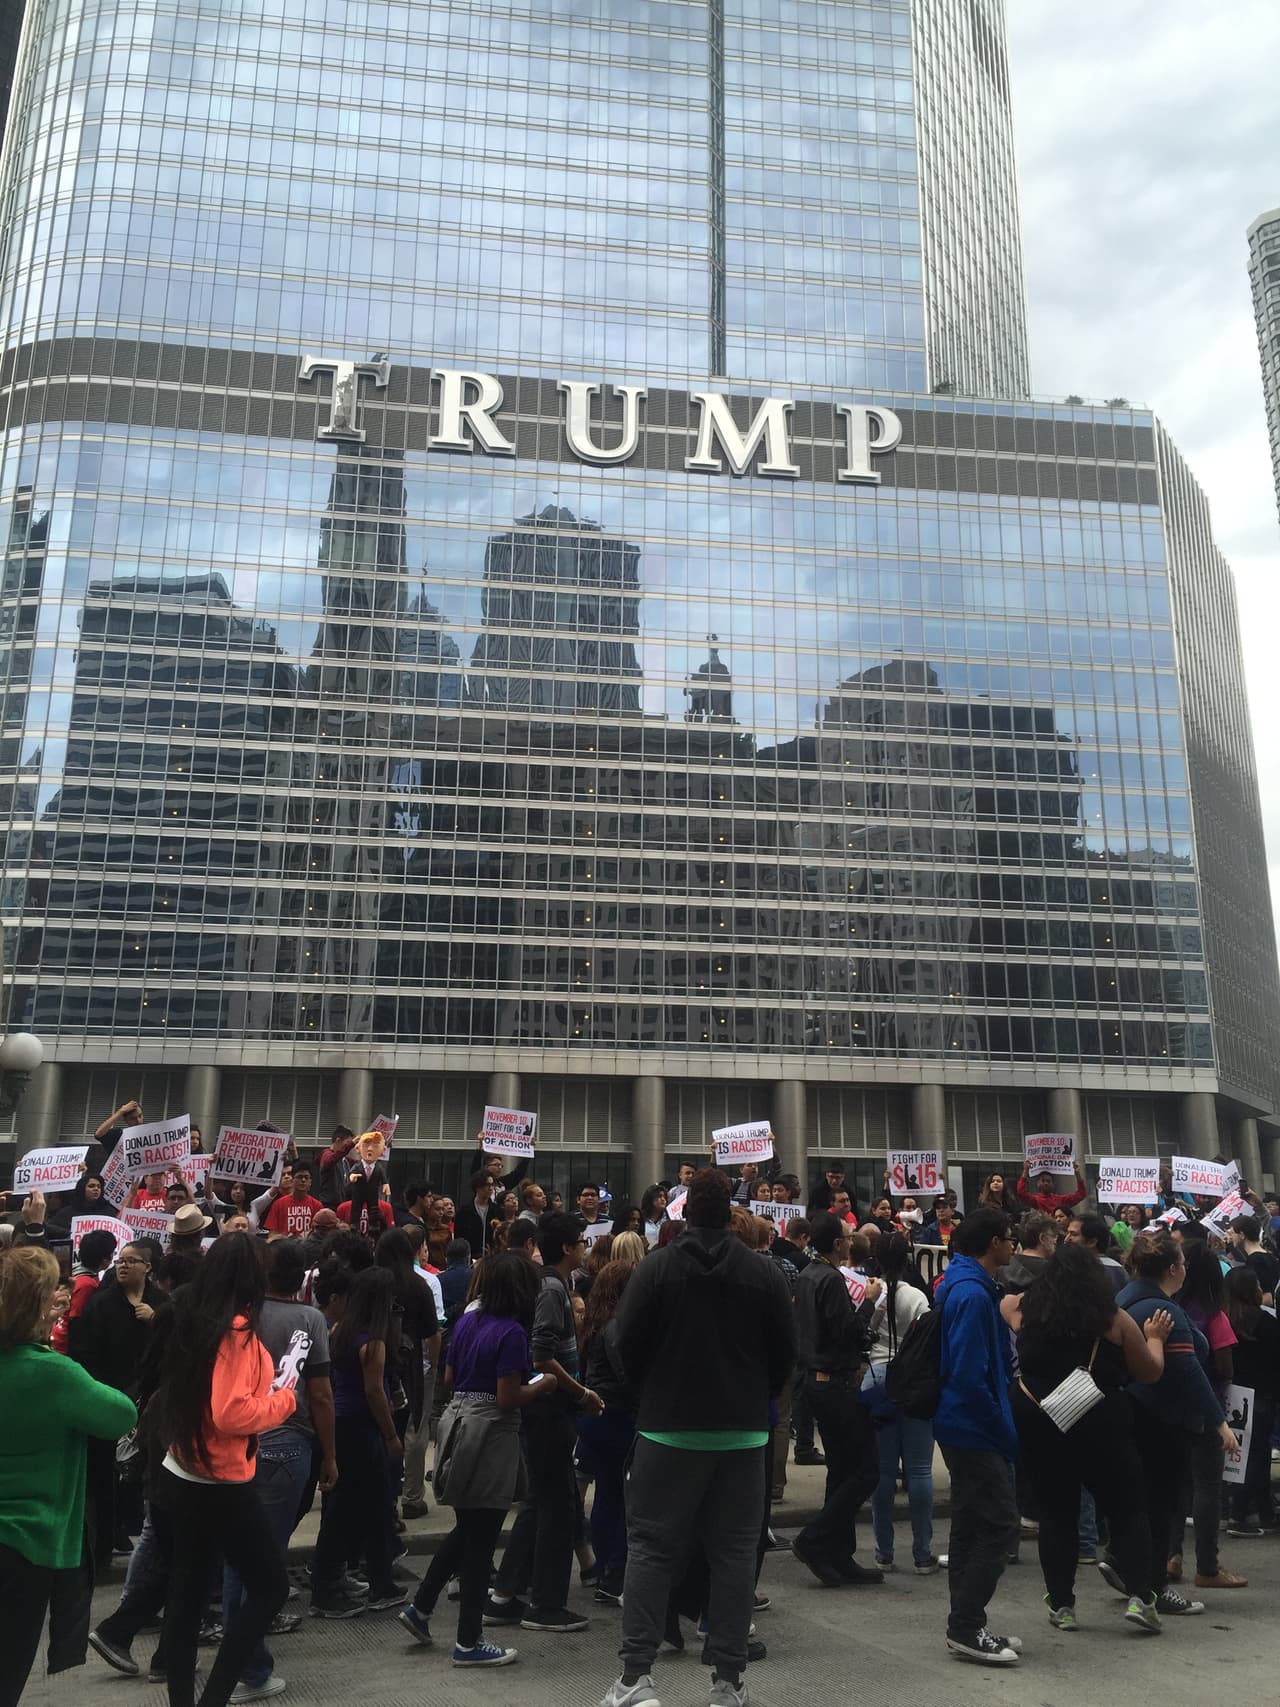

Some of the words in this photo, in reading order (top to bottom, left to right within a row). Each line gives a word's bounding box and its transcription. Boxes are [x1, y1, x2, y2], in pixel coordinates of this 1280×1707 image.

[299, 355, 903, 484] TRUMP
[486, 1121, 503, 1131] FIGHT
[504, 1124, 514, 1133] FOR
[747, 1128, 769, 1138] TRUMP
[125, 1133, 161, 1151] DONALD
[163, 1126, 189, 1143] TRUMP
[223, 1130, 285, 1150] IMMIGRATION
[485, 1131, 516, 1140] NATIONAL
[484, 1137, 496, 1145] OF
[498, 1140, 530, 1150] ACTION
[718, 1141, 729, 1154] IS
[127, 1152, 141, 1168] IS
[144, 1140, 189, 1164] RACIST!
[219, 1143, 266, 1162] REFORM
[891, 1154, 918, 1164] FIGHT
[921, 1153, 937, 1164] FOR
[24, 1155, 53, 1167] ONALD
[56, 1153, 83, 1164] TRUMP
[1038, 1159, 1071, 1168] ACTION
[215, 1157, 256, 1177] NOW!
[1101, 1168, 1131, 1178] DONALD
[1134, 1168, 1157, 1178] TRUMP
[17, 1169, 31, 1184] IS
[1176, 1169, 1188, 1182] IS
[1102, 1179, 1113, 1192] IS
[287, 1206, 311, 1217] LUCHA
[755, 1204, 781, 1218] FIGHT
[783, 1207, 800, 1219] FOR
[125, 1214, 168, 1231] NOVEMBER
